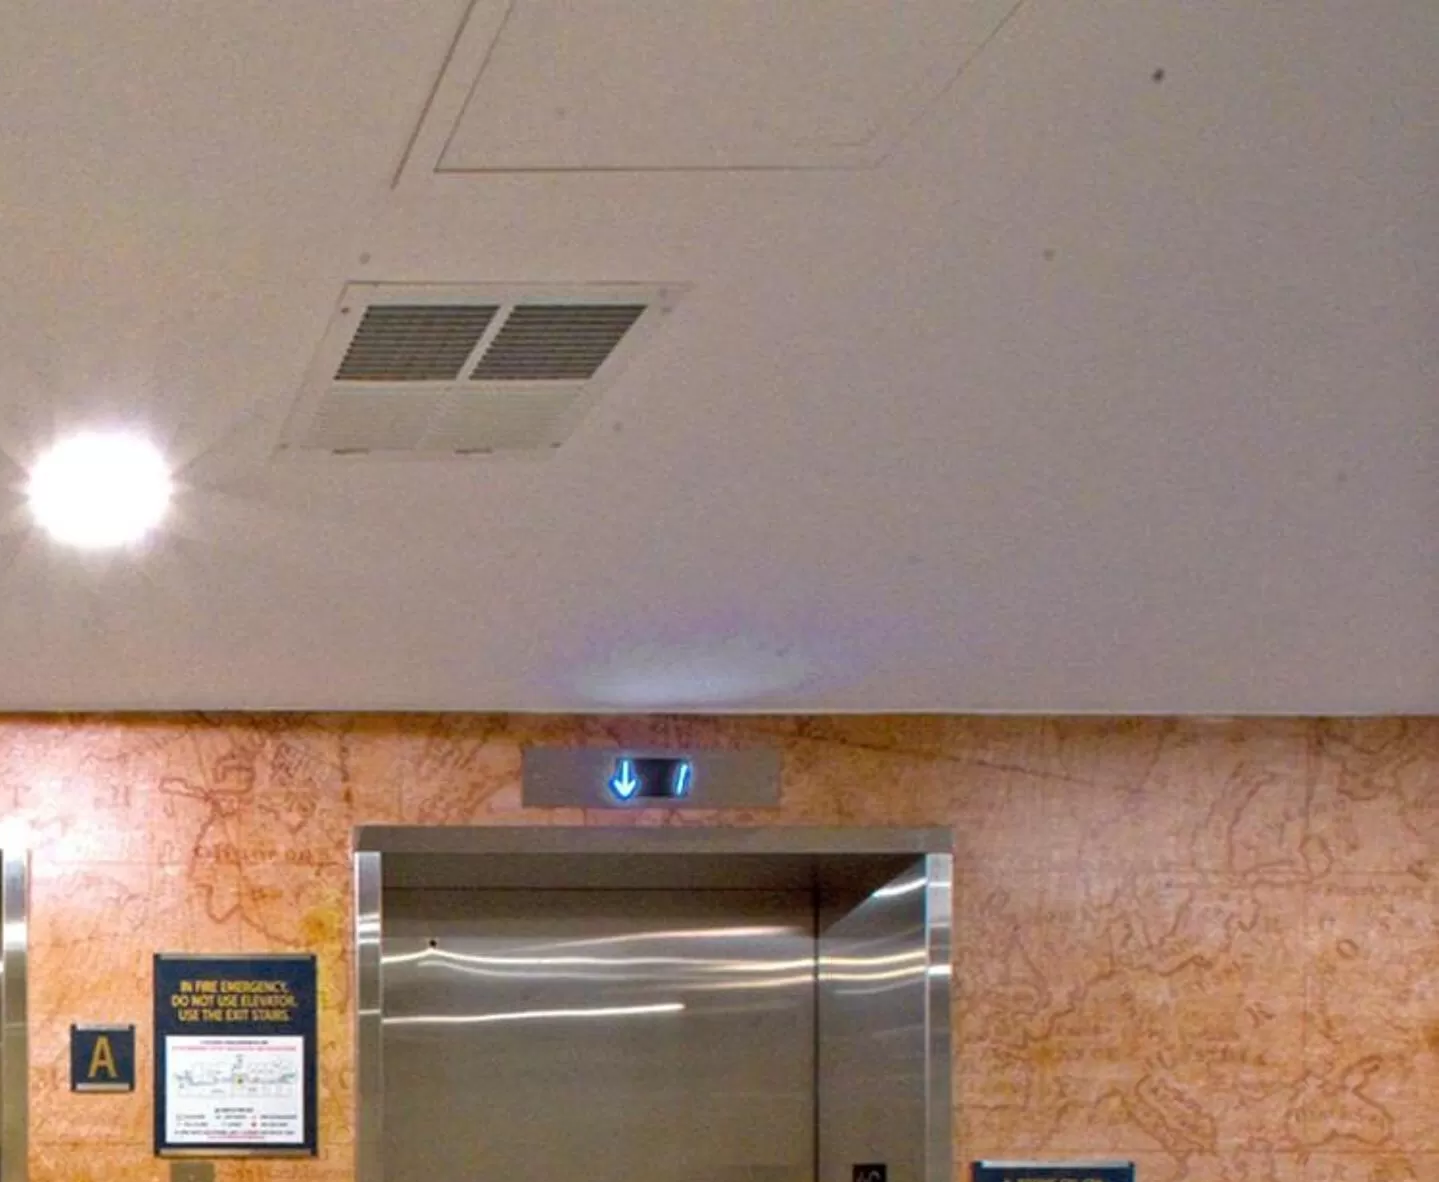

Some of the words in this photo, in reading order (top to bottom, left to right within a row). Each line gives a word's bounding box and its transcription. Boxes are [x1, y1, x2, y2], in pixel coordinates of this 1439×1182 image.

[675, 763, 689, 795] 1
[179, 980, 192, 993] IN
[195, 980, 218, 993] FIRE
[171, 994, 189, 1007] DO
[191, 994, 215, 1007] NOT
[217, 994, 238, 1007] USE
[178, 1008, 200, 1021] USE
[202, 1008, 223, 1021] THE
[225, 1008, 249, 1021] EXIT
[87, 1034, 117, 1079] A
